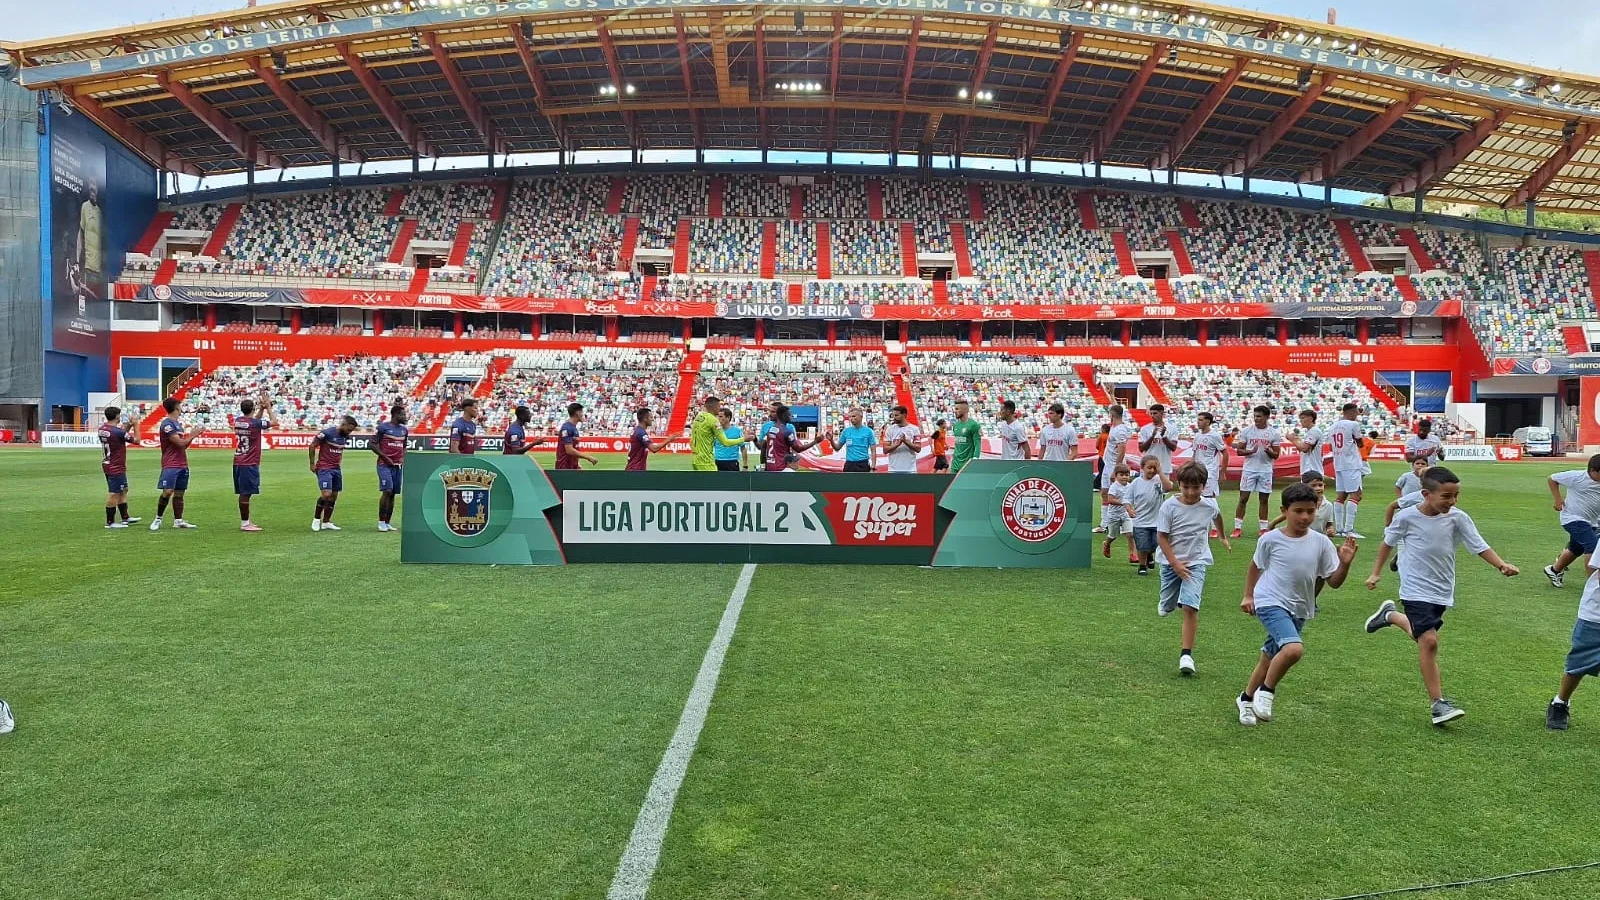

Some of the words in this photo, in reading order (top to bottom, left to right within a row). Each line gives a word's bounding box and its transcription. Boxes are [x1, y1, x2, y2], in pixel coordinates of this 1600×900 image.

[226, 36, 254, 51] DE
[265, 23, 342, 45] LEIRIA
[964, 1, 1118, 29] TORNAR-SE
[1132, 21, 1285, 54] REALIADE
[1300, 48, 1330, 63] SE
[737, 304, 783, 317] UNIÃO
[787, 305, 805, 317] DE
[808, 305, 852, 317] LEIRIA
[1201, 304, 1240, 316] FIXAR
[44, 435, 60, 444] LIGA
[61, 435, 94, 444] PORTUGAL
[1332, 432, 1345, 449] 19
[1447, 448, 1479, 457] PORTUGAL
[1481, 448, 1486, 457] 2
[1004, 483, 1026, 508] UNIÃO
[1028, 480, 1040, 489] DE
[1042, 482, 1064, 510] LEIRIA
[579, 501, 633, 532] LIGA
[640, 501, 760, 532] PORTUGAL
[774, 502, 789, 533] 2
[452, 522, 483, 531] SCUT
[853, 519, 917, 541] super
[1013, 525, 1053, 538] PORTUGAL
